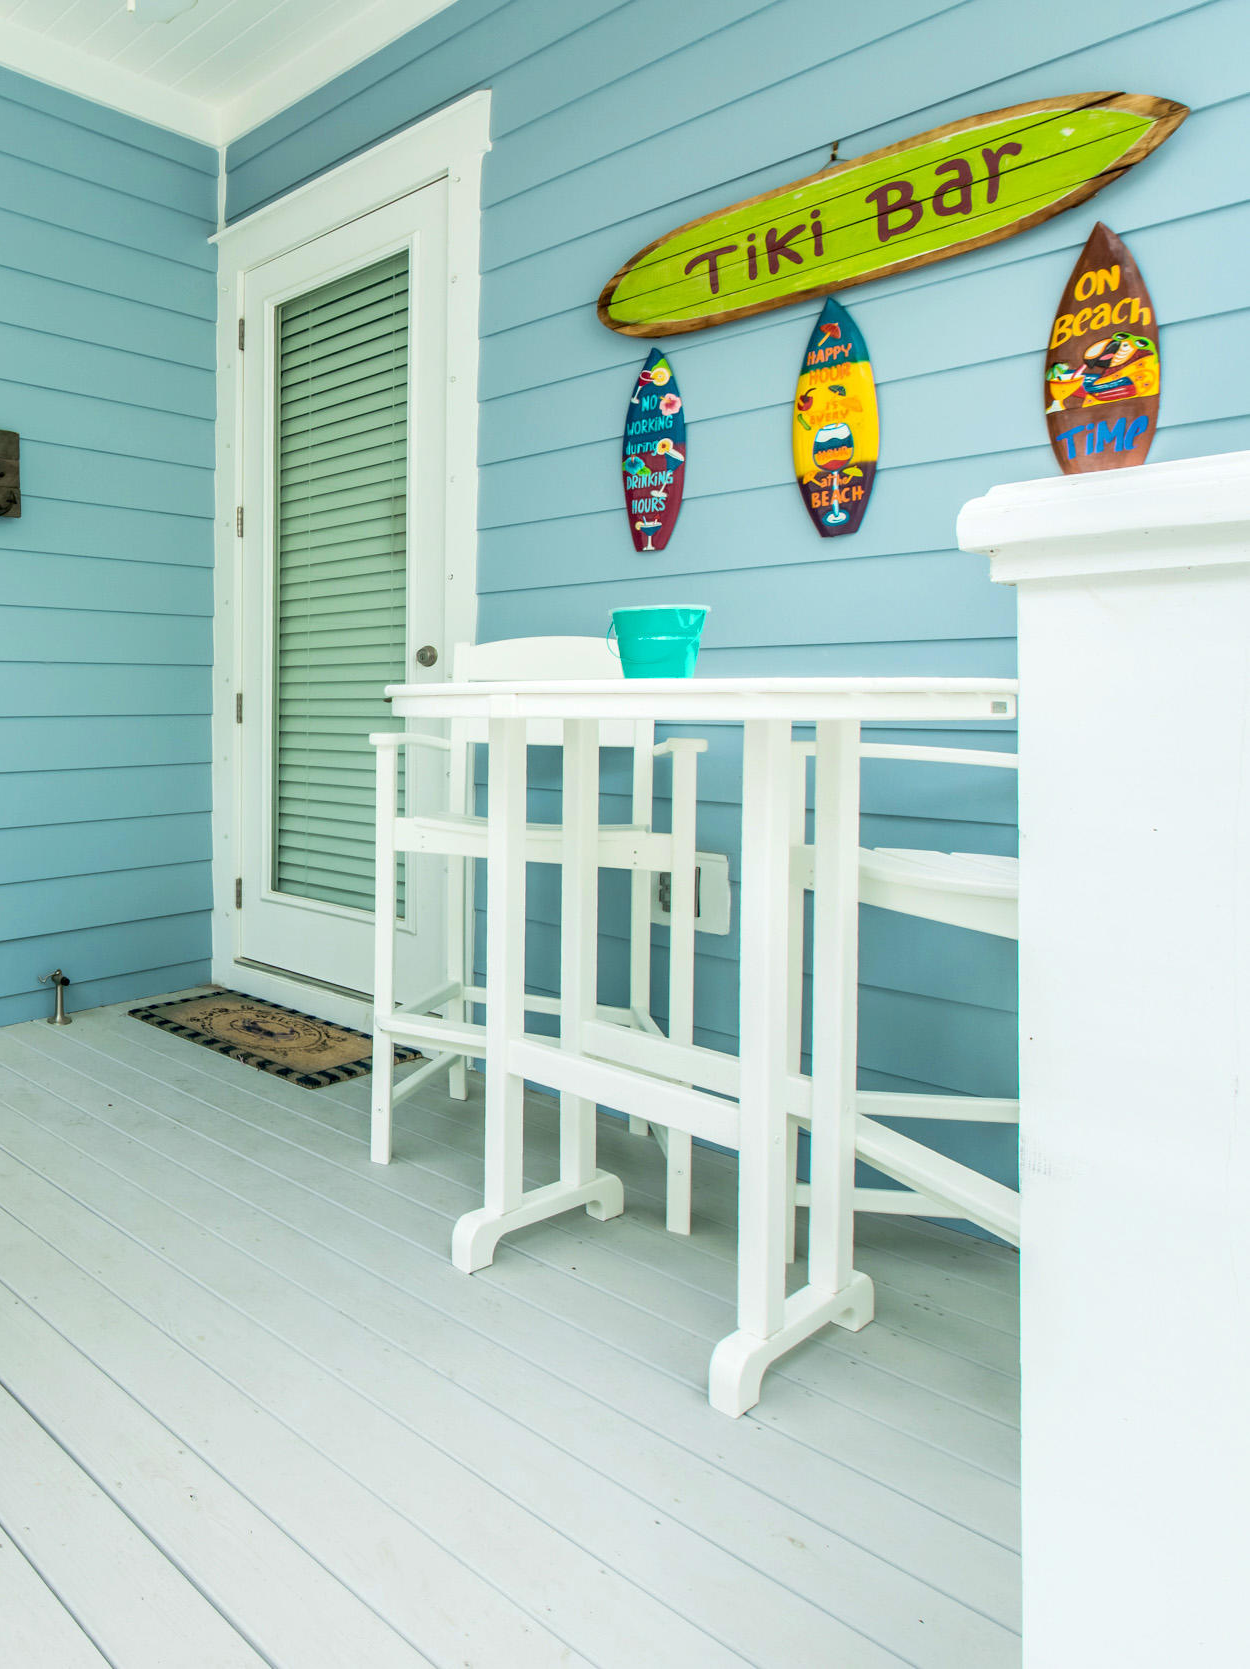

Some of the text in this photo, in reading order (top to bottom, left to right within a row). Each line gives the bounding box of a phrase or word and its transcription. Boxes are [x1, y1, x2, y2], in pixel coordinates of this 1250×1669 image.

[684, 142, 1023, 294] Tiki Bar
[1074, 264, 1121, 302] ON
[1050, 297, 1152, 350] Beach
[807, 343, 852, 366] HAPPY
[809, 362, 851, 386] HOUR
[641, 394, 658, 412] NO
[626, 440, 659, 456] during
[632, 497, 667, 514] HOURS
[811, 486, 865, 509] BEACH
